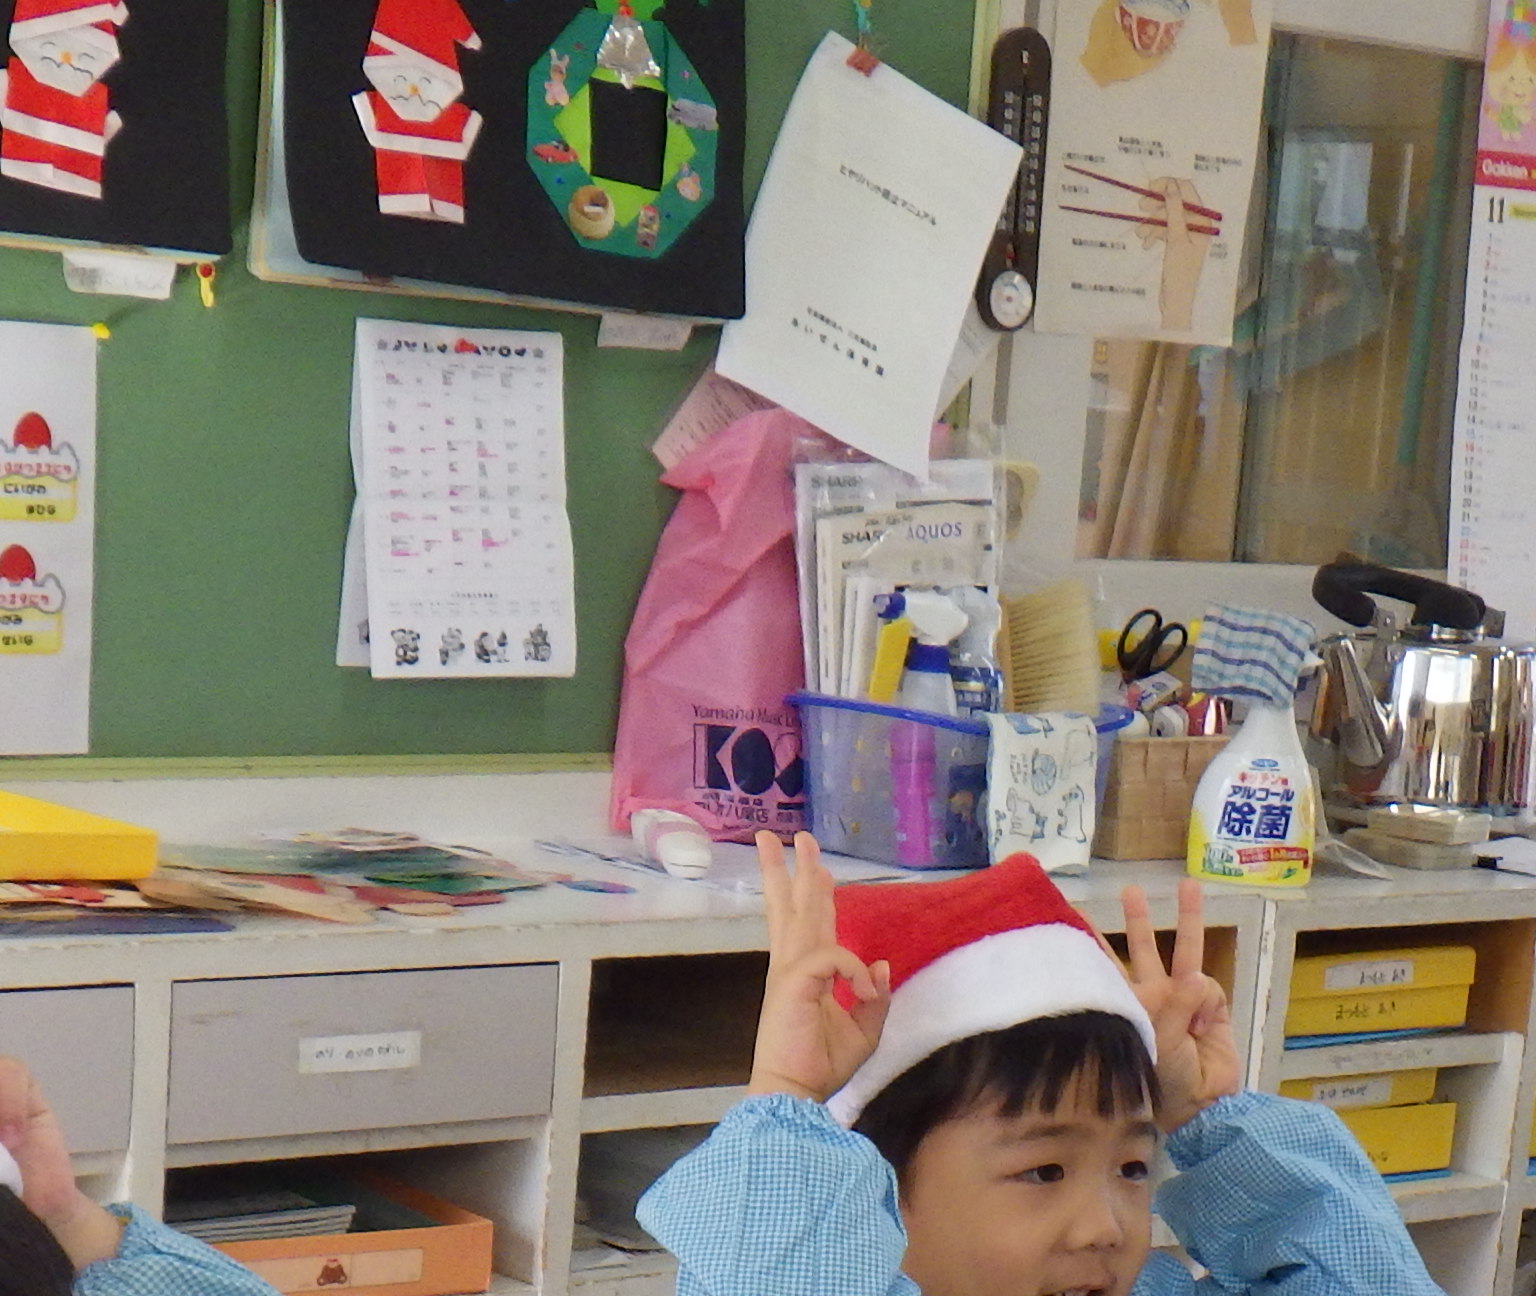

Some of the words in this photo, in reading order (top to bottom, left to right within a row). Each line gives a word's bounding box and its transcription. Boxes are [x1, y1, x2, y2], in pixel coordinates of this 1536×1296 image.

[1489, 196, 1505, 222] 11
[907, 522, 962, 544] AQUOS
[692, 704, 756, 719] Yamaha
[1227, 785, 1295, 802] アルコール
[1217, 801, 1293, 840] 除菌
